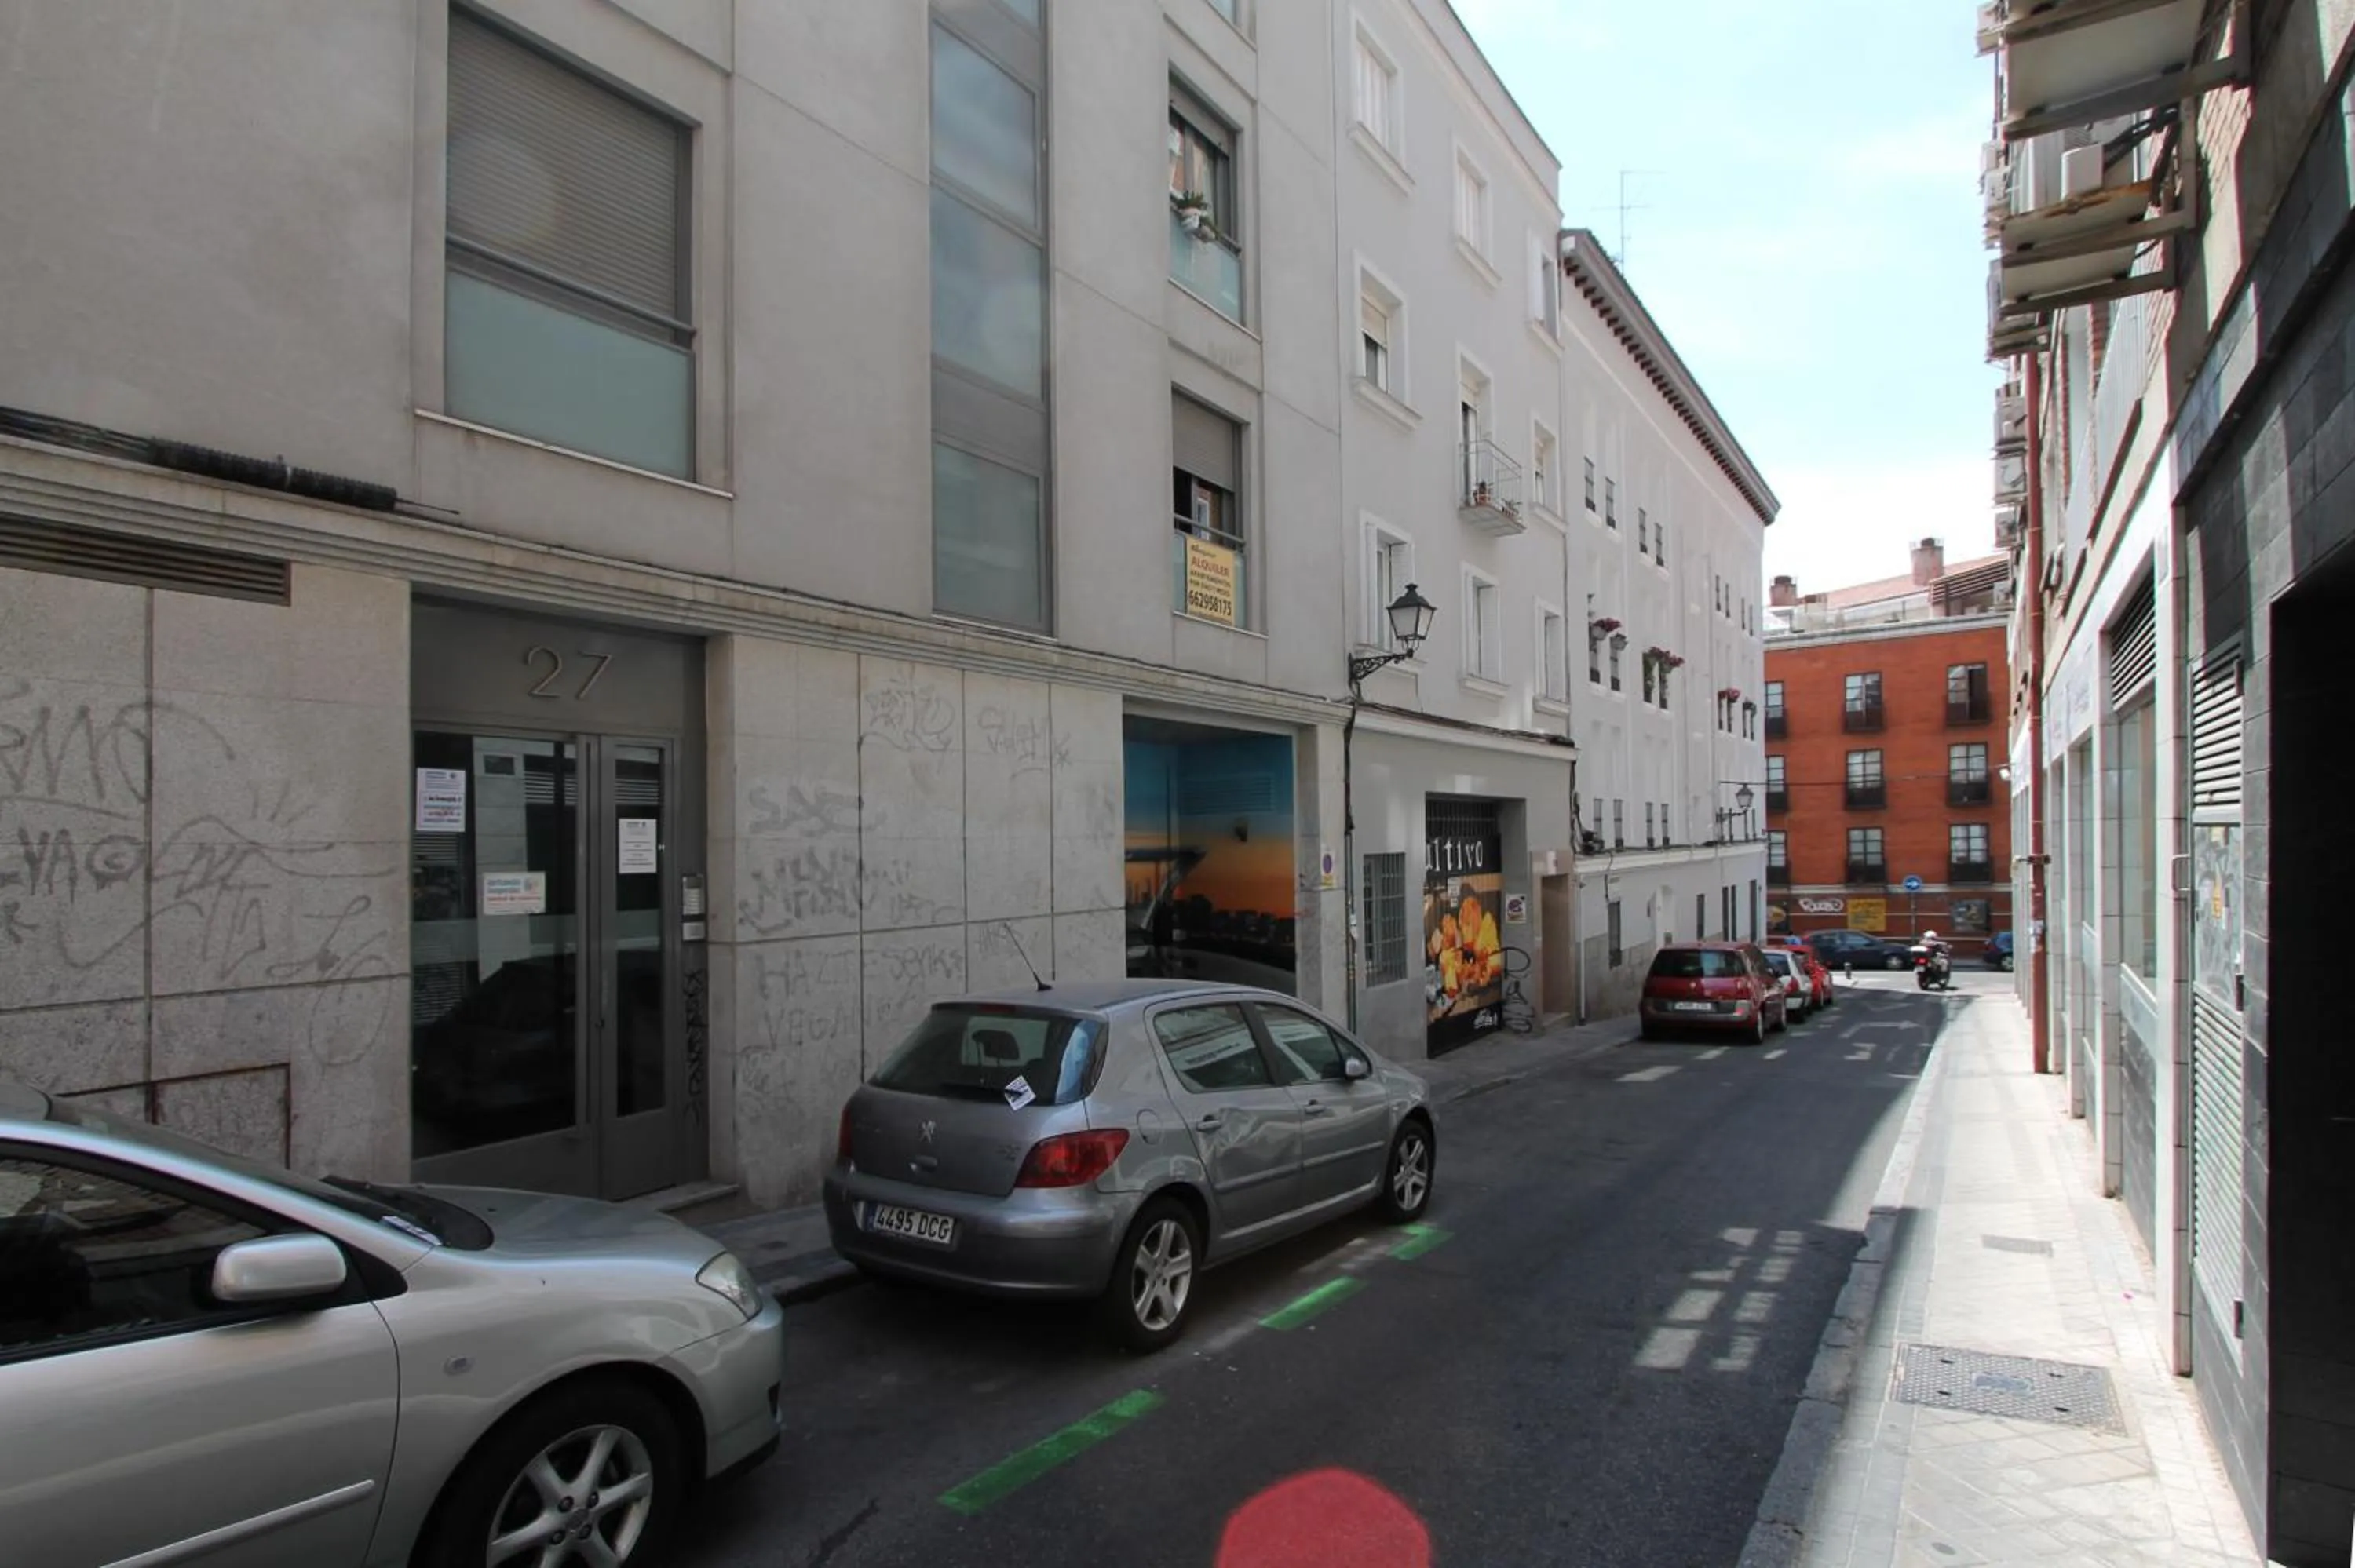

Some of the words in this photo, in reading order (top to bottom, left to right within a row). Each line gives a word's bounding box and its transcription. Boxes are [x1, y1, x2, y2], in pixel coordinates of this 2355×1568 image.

[1191, 556, 1231, 578] ALQUILER
[1189, 589, 1232, 616] 662958175
[524, 645, 612, 700] 27
[877, 1208, 914, 1232] 4495
[917, 1213, 951, 1239] DCG
